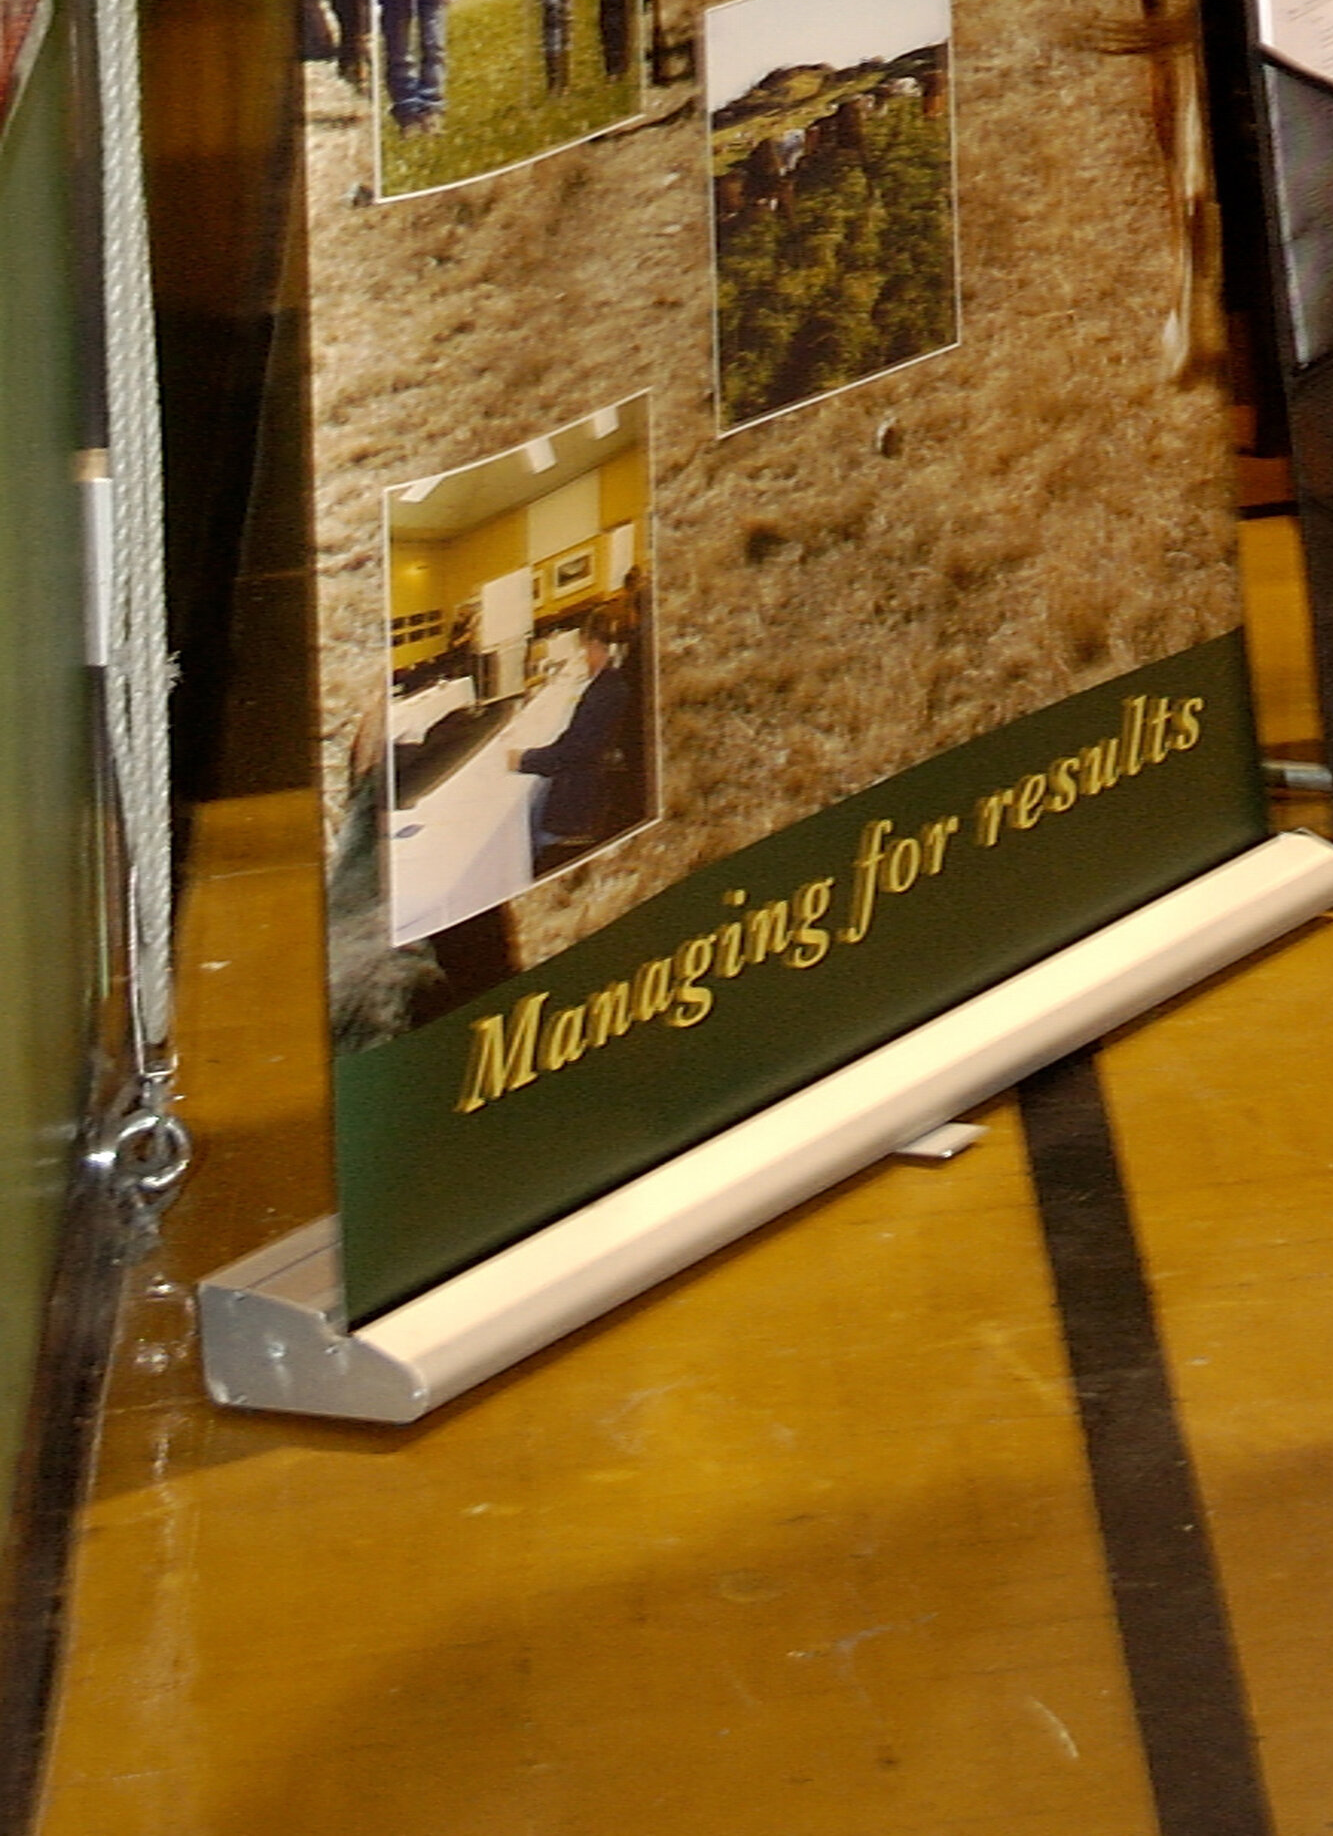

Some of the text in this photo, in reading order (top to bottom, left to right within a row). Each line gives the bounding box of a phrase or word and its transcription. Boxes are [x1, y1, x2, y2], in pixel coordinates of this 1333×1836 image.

[455, 694, 1205, 1114] Managing for results
